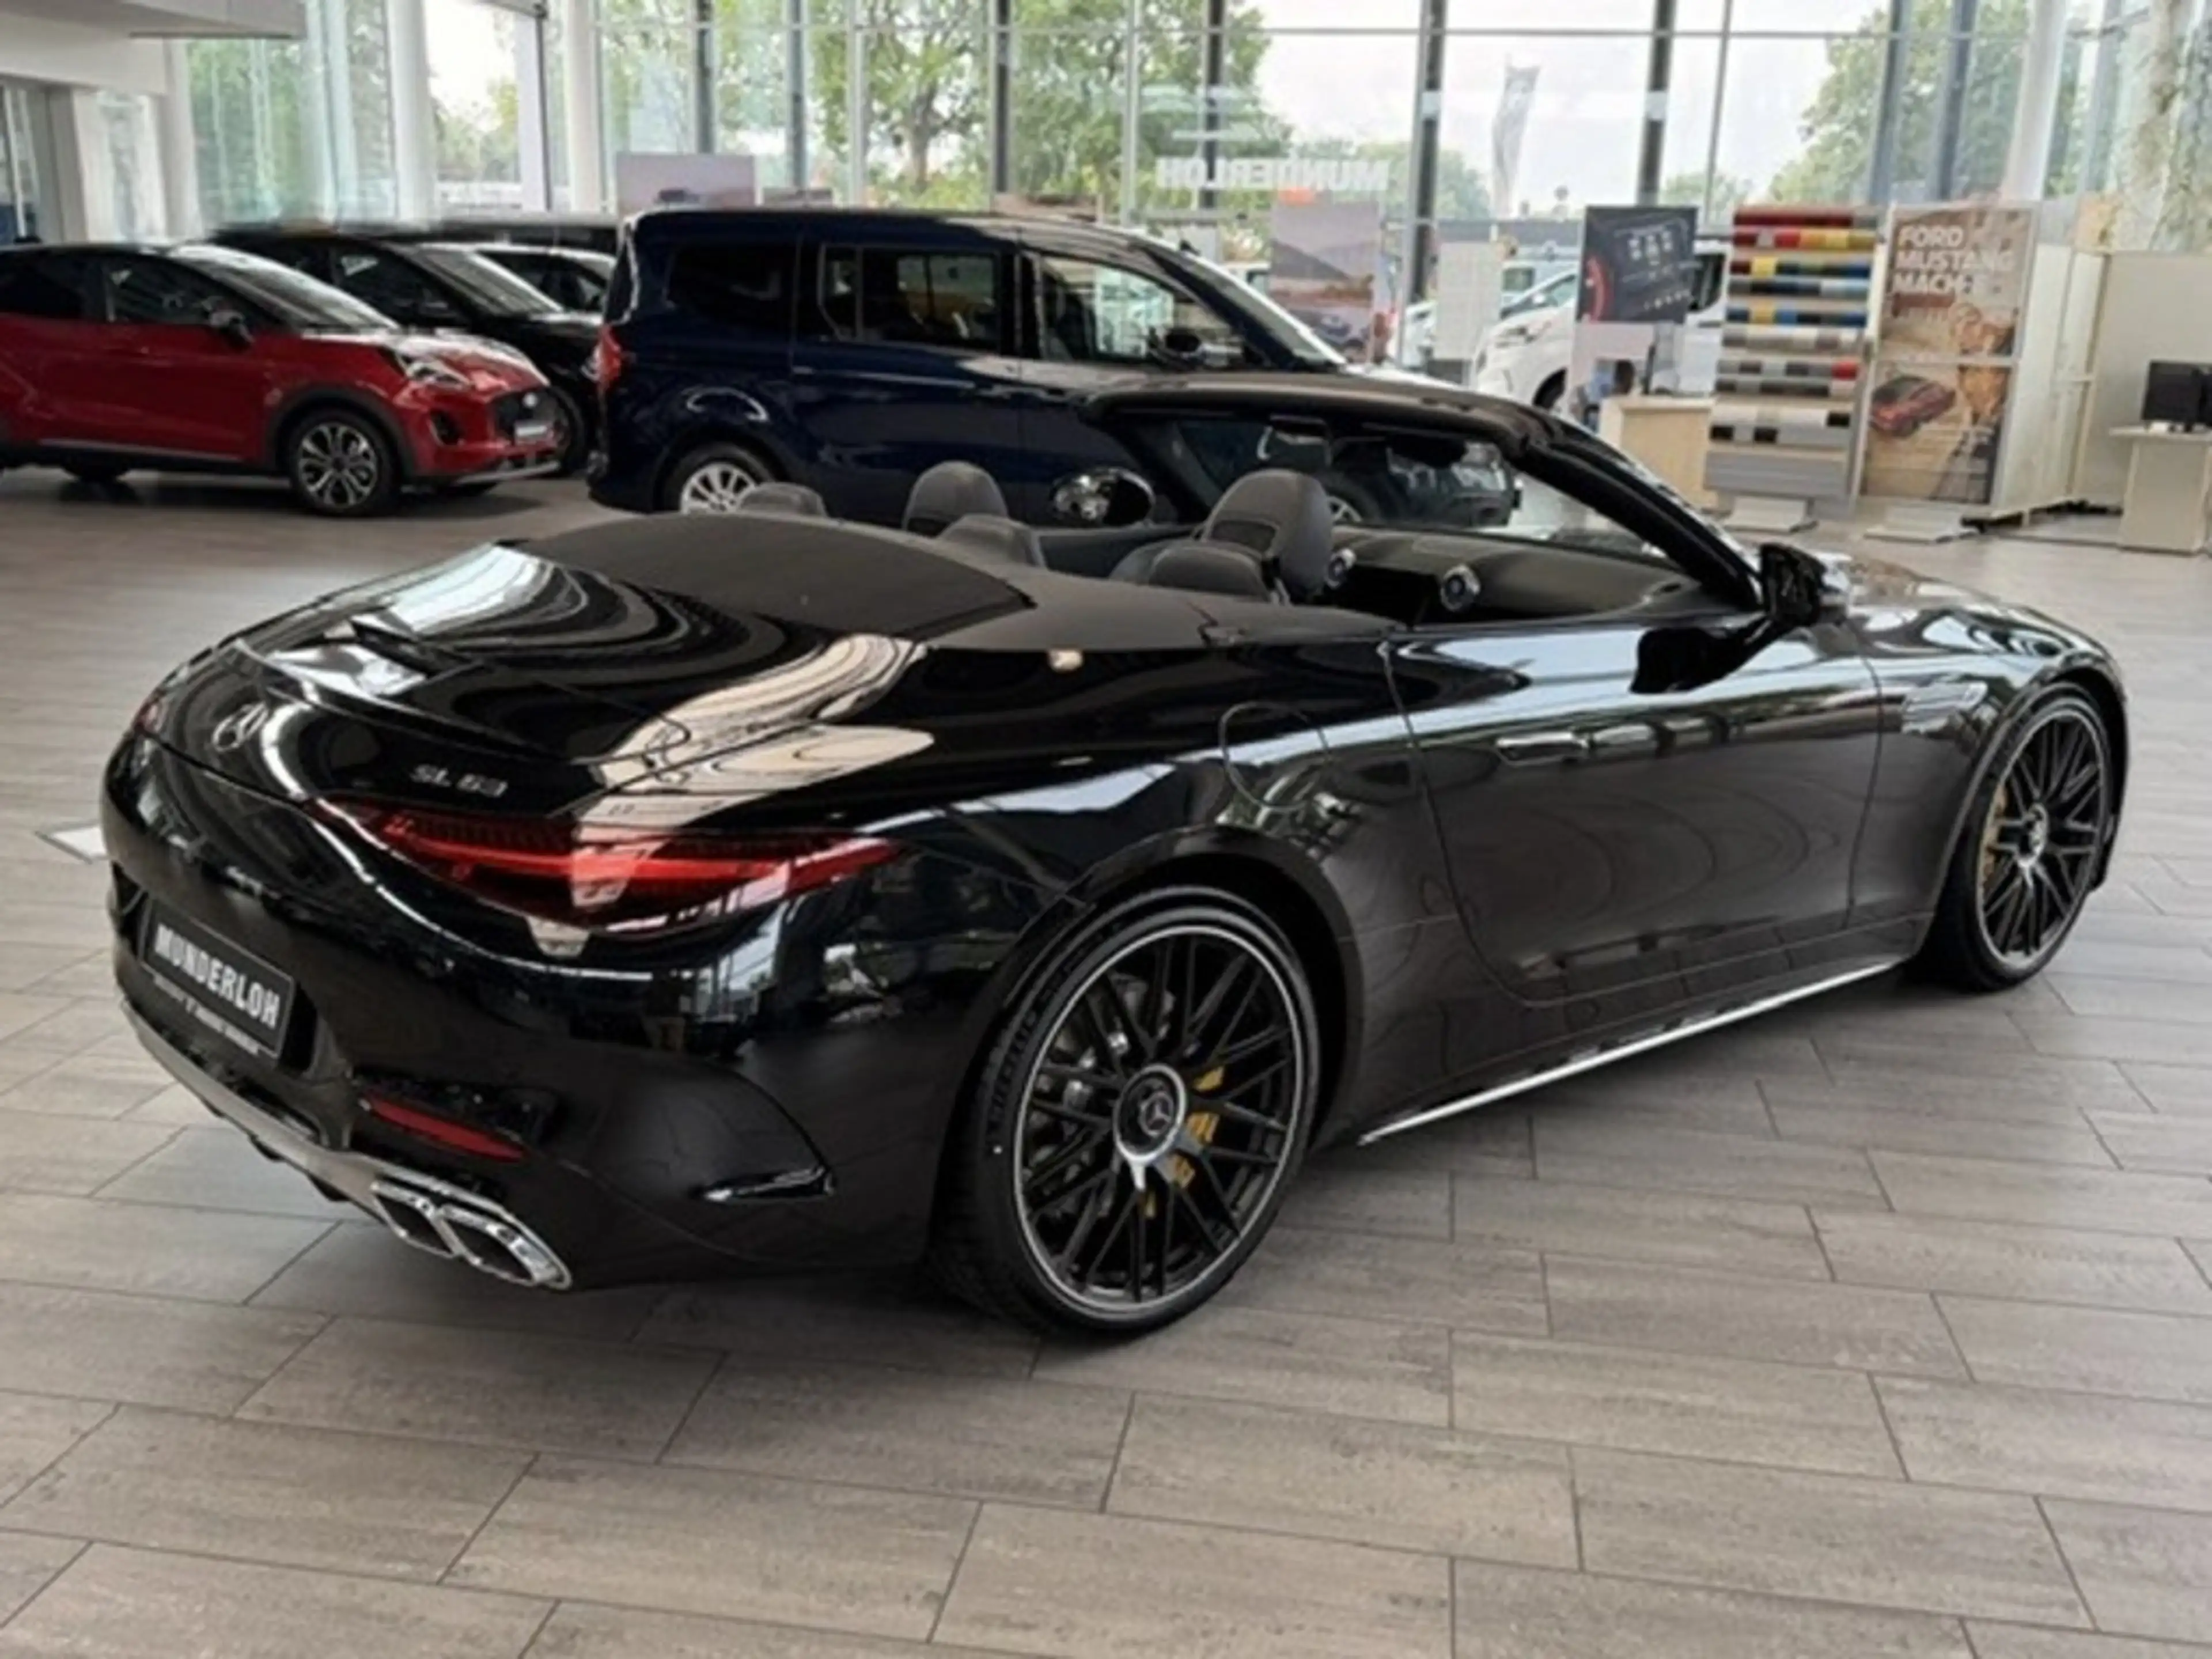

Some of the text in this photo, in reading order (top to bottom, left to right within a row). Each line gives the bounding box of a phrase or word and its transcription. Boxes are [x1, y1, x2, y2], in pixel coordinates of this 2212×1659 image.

[1898, 225, 1963, 248] FORD
[1896, 249, 2016, 271] MUSTANG
[410, 764, 508, 798] SL 63
[155, 923, 280, 1030] MUNDERLOH
